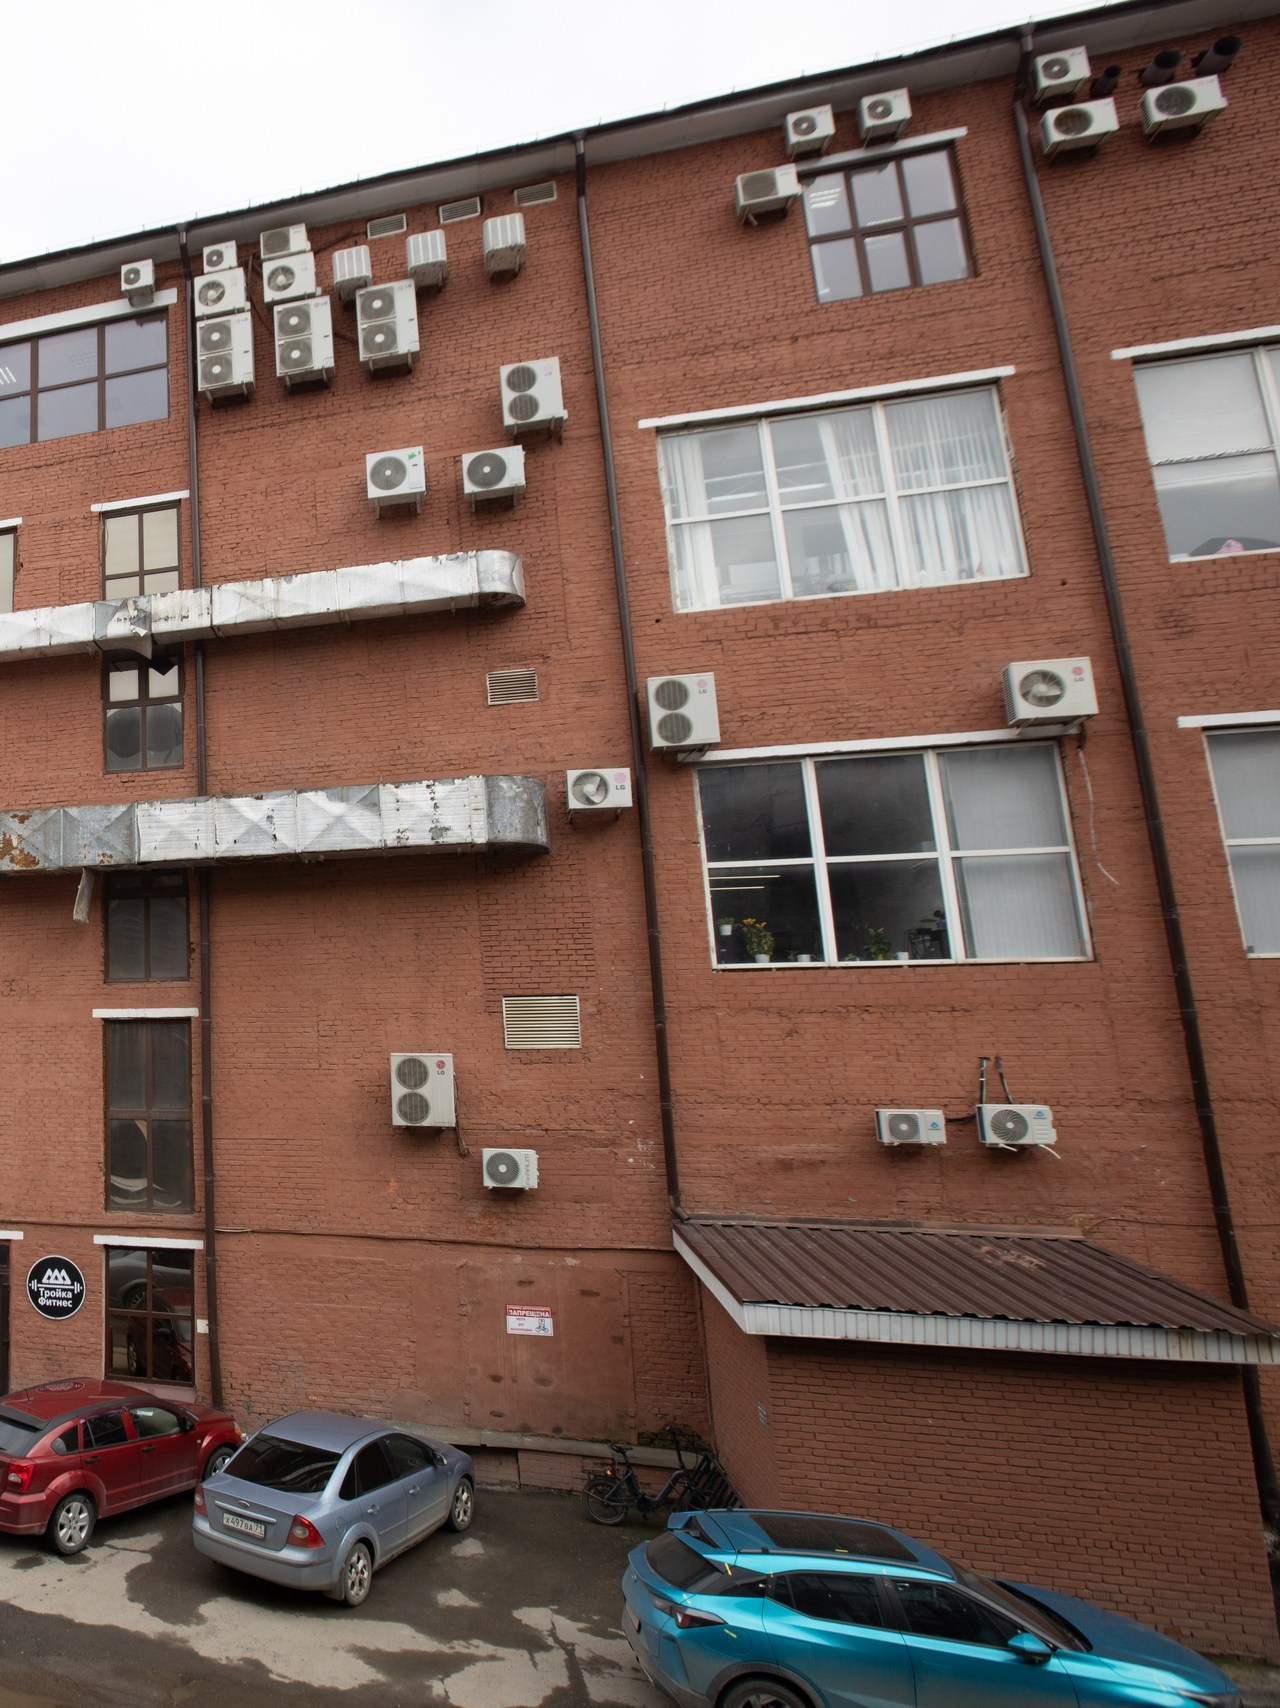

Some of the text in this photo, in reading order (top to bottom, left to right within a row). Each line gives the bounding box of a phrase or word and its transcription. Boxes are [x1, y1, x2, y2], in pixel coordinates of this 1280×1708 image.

[38, 1288, 72, 1298] Тройка
[38, 1297, 72, 1307] Фитнес
[509, 1309, 550, 1318] ЗАПРЕЩЕНА
[225, 1517, 253, 1531] Х497ВА
